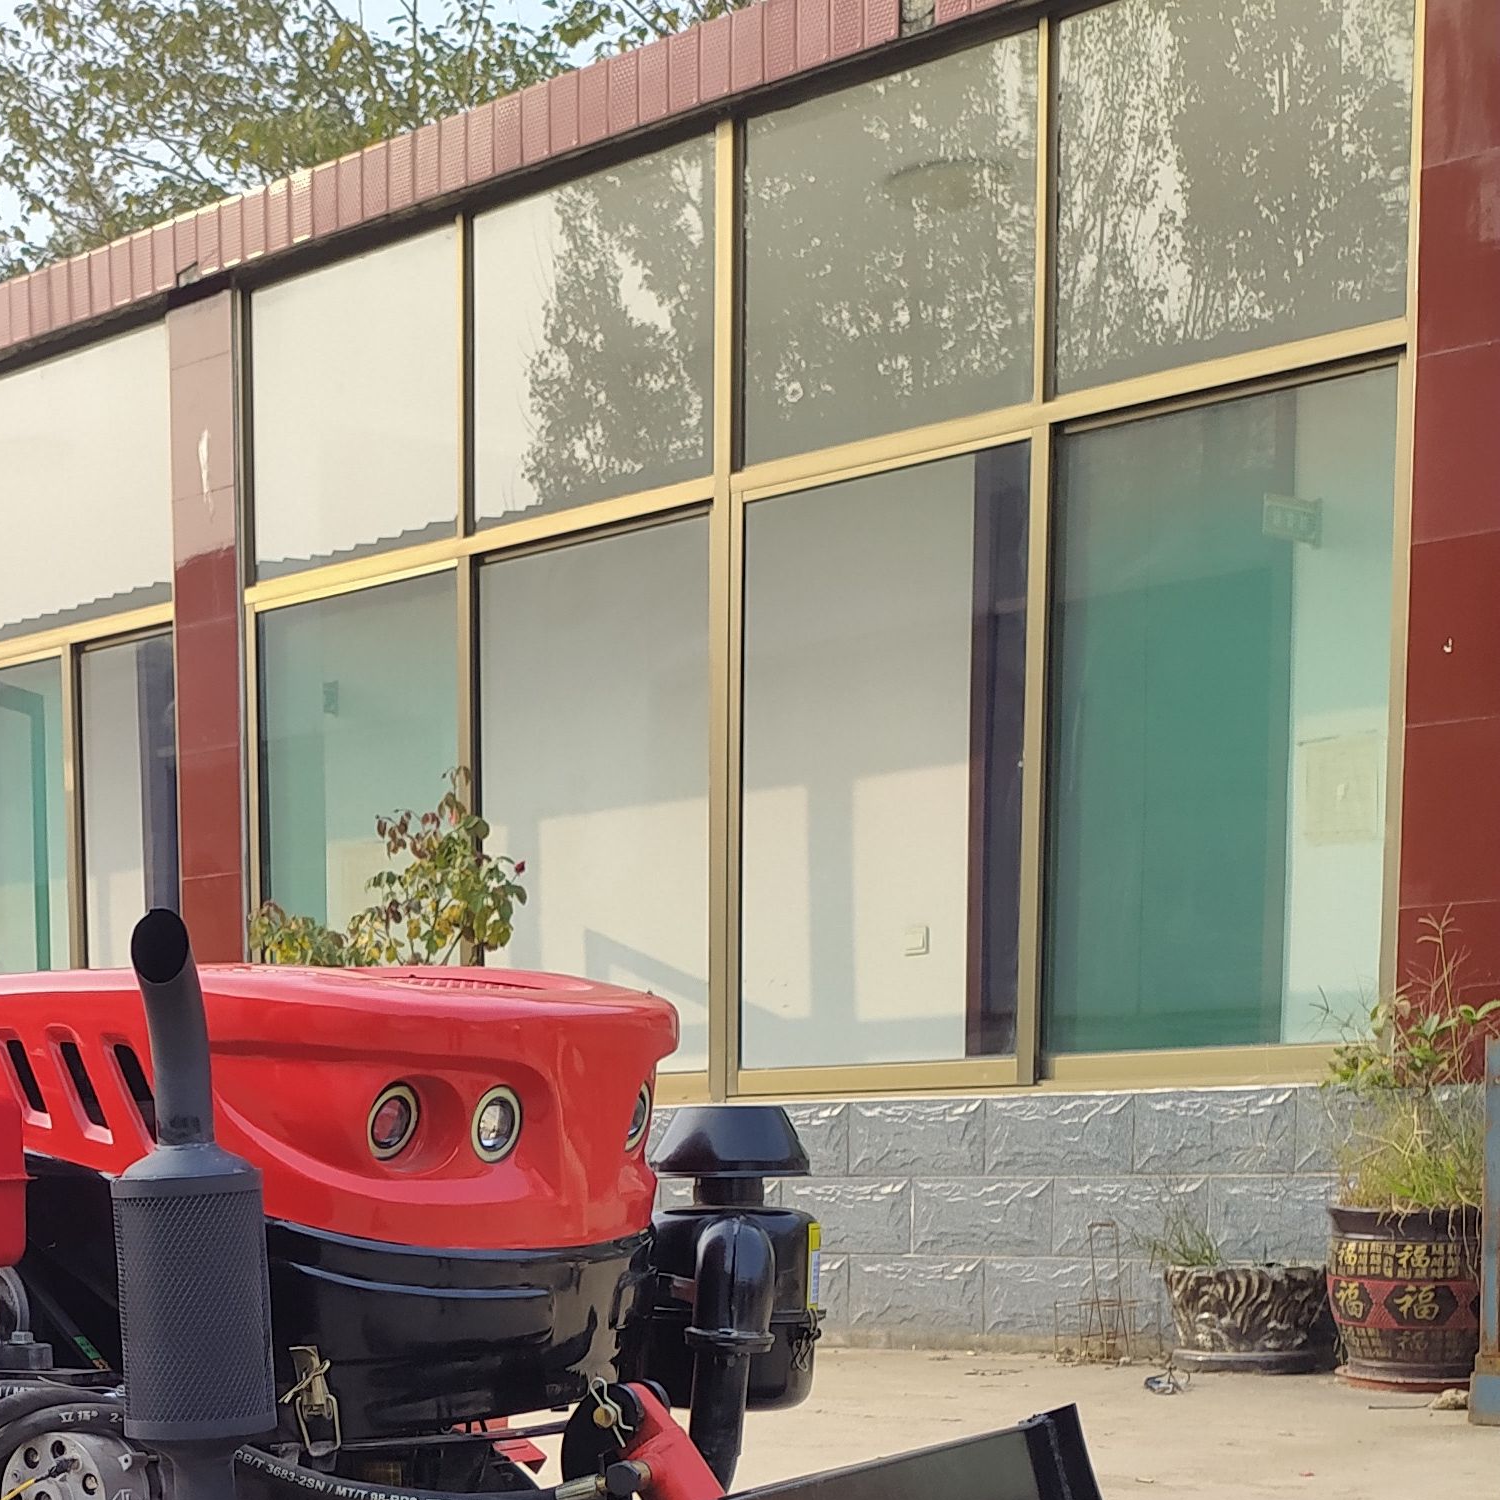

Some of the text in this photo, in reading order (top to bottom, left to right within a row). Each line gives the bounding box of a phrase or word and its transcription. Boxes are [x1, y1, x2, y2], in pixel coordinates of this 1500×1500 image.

[1396, 1244, 1430, 1269] 福
[1335, 1281, 1439, 1320] 福 福
[234, 1449, 265, 1470] GB/T
[265, 1463, 326, 1492] 3683-2SN
[335, 1485, 368, 1500] MT/T
